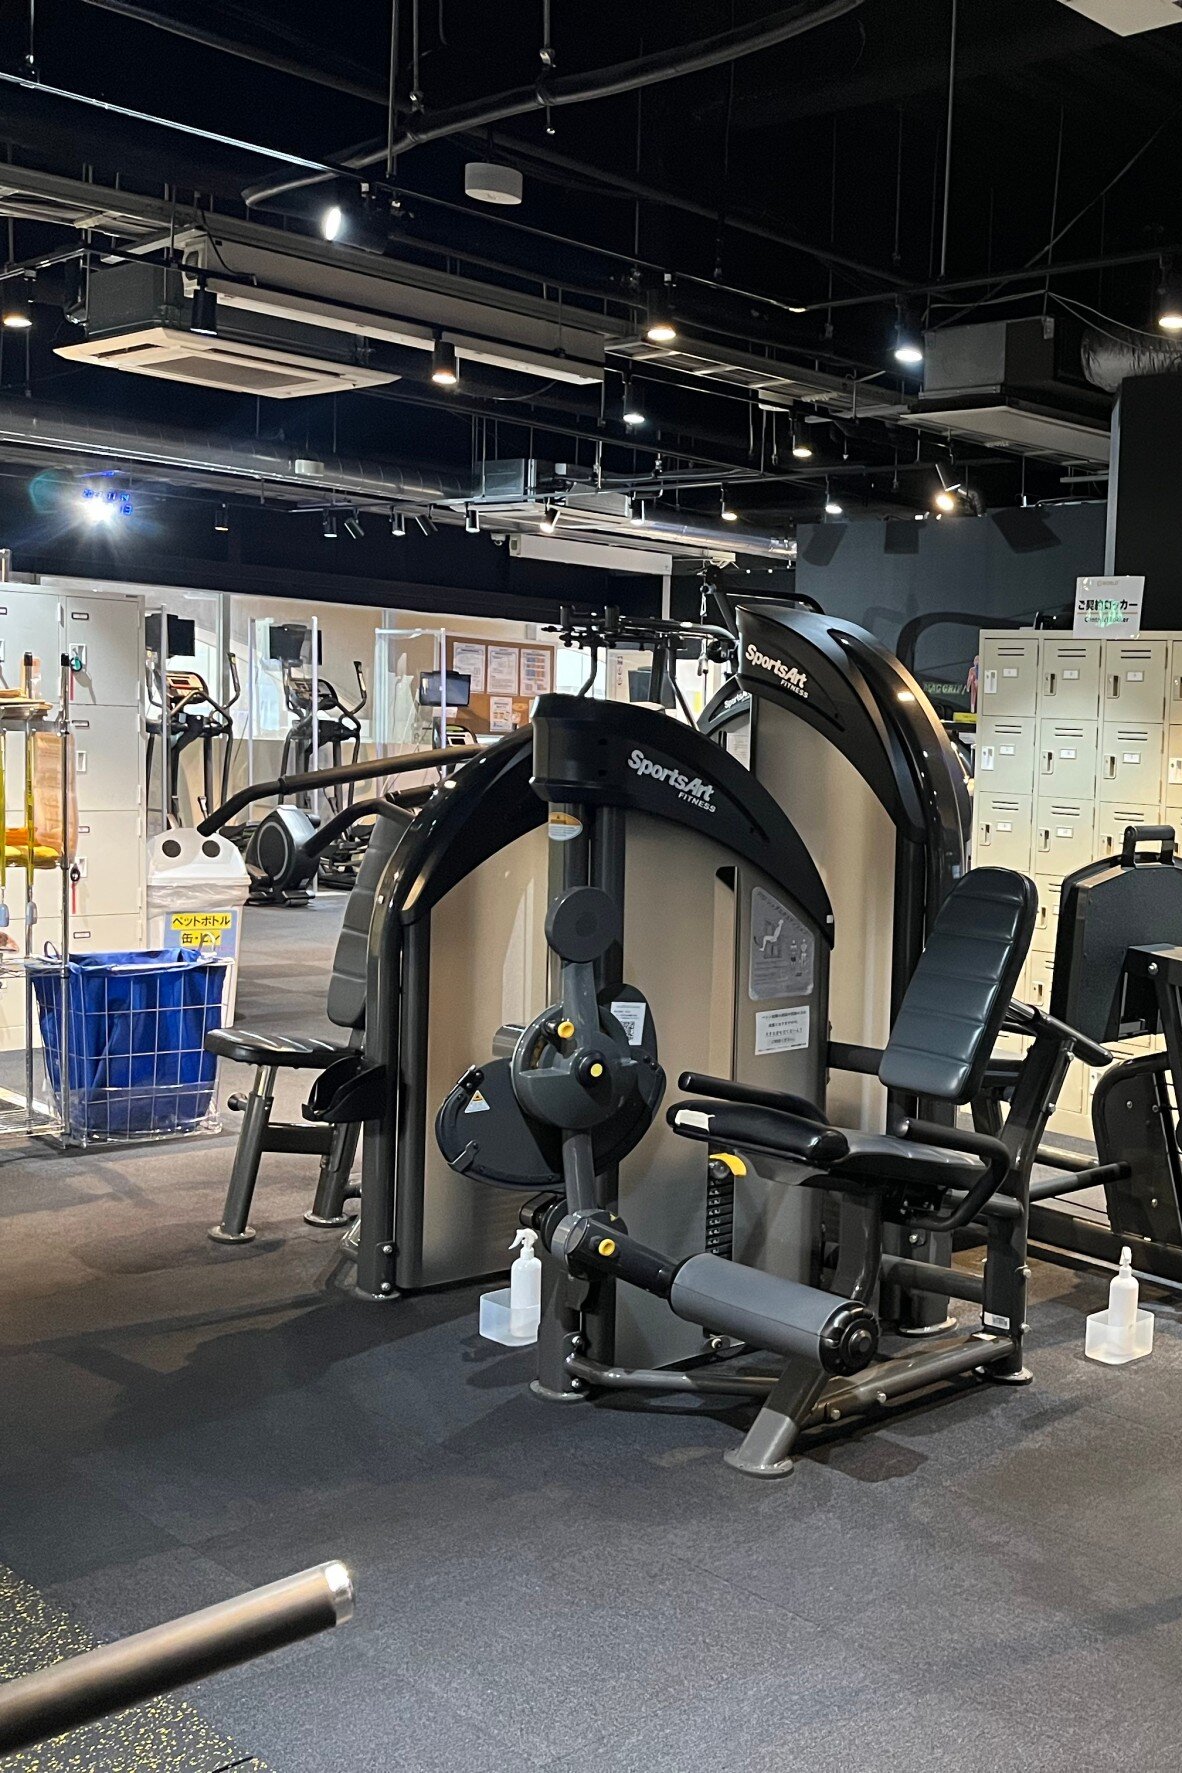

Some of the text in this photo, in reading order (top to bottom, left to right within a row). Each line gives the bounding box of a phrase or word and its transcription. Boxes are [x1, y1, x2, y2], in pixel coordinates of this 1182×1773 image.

[745, 643, 808, 688] SportsArt
[780, 679, 809, 699] FITNESS
[628, 749, 715, 802] SportsArt
[678, 791, 717, 813] FITNESS
[172, 915, 231, 927] ペットボトル
